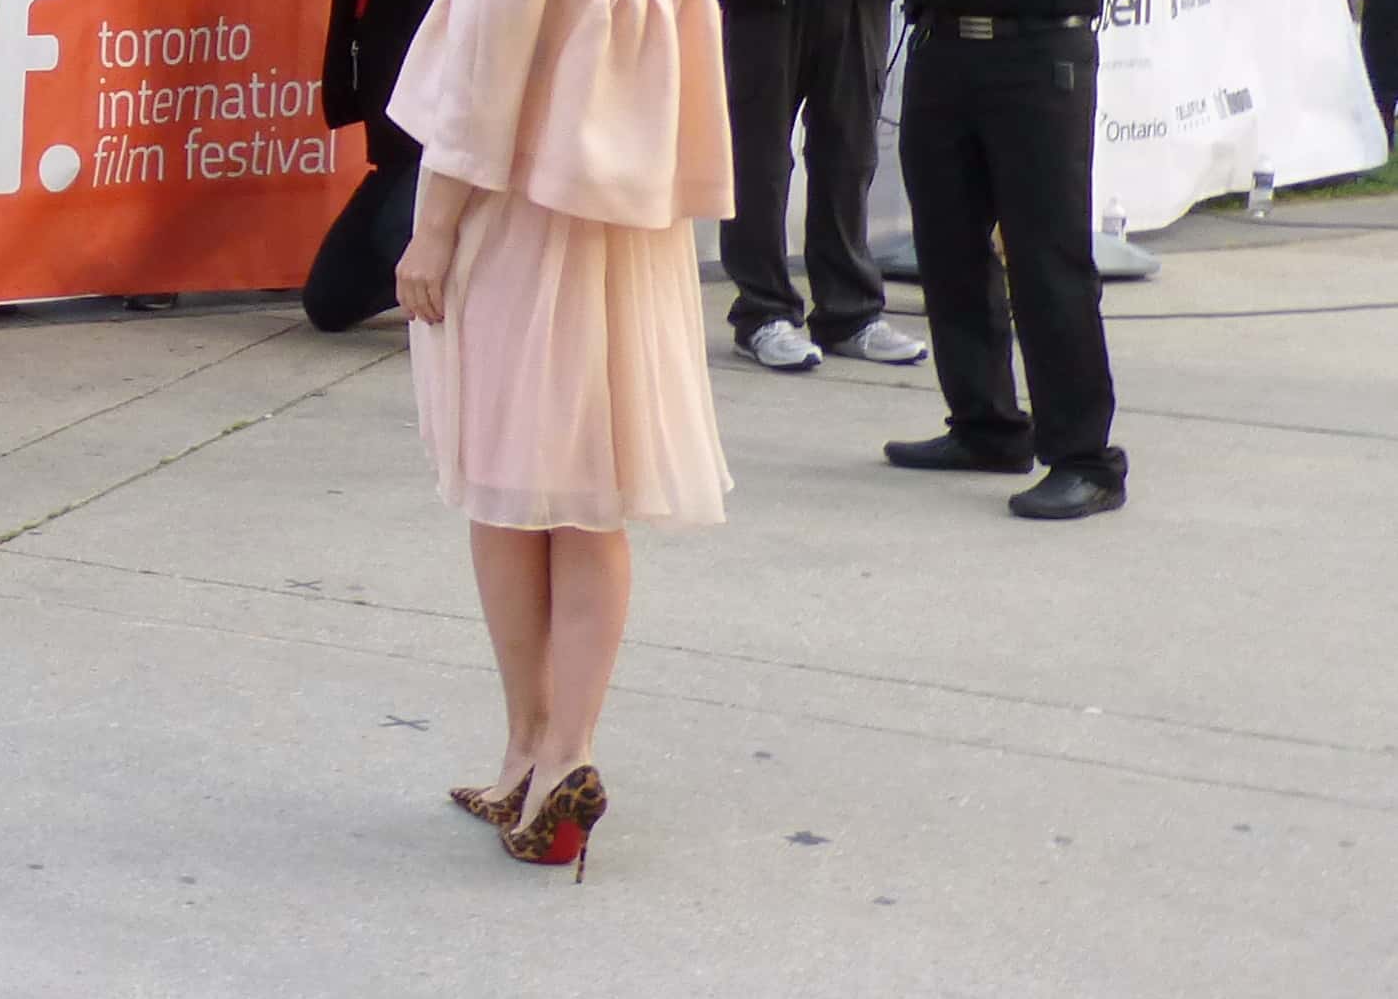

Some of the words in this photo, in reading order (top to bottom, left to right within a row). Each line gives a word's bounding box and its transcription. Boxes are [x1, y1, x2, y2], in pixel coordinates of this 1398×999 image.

[98, 16, 251, 69] toronto
[1106, 117, 1168, 143] Ontario
[92, 134, 166, 188] film
[184, 126, 337, 180] festival
